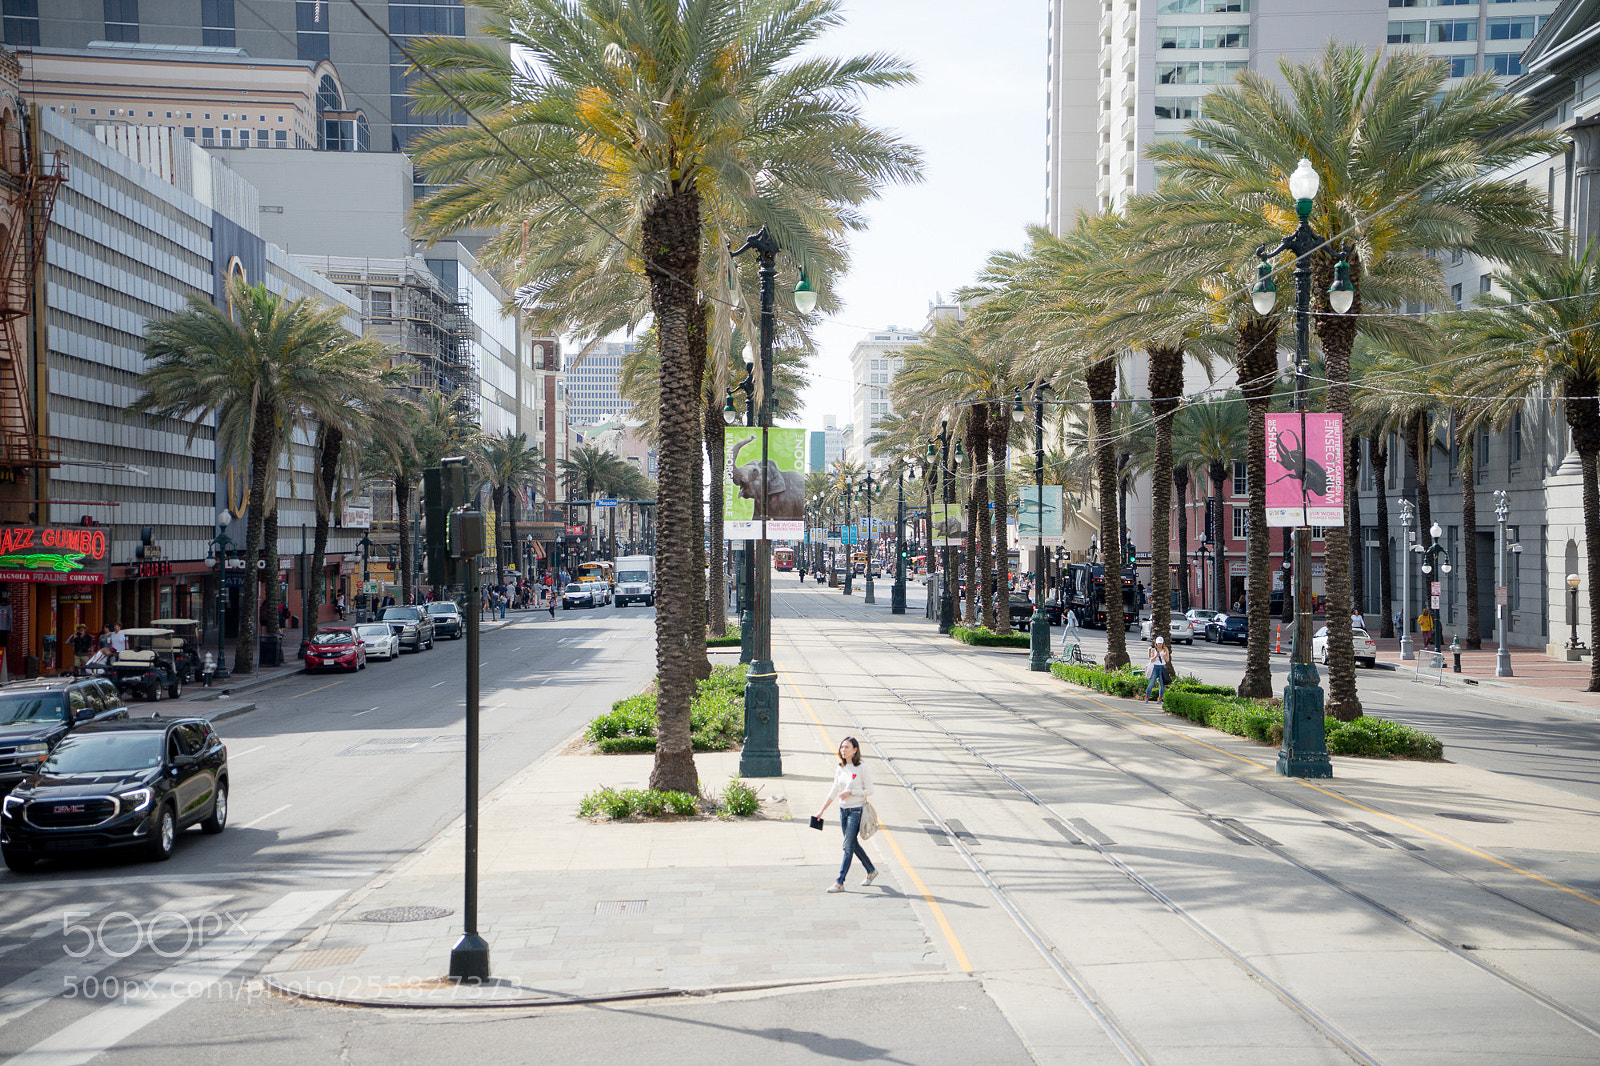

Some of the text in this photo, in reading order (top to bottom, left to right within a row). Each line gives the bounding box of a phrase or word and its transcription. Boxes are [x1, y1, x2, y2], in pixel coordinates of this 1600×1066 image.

[794, 438, 804, 470] ZOO
[1268, 427, 1277, 463] SHARP
[725, 438, 734, 517] UNFORGETTABLE
[1325, 426, 1335, 504] INSECTARIUM
[42, 528, 105, 560] GUMBO
[32, 573, 67, 582] PRALINE
[69, 574, 99, 582] COMPANY
[139, 562, 159, 577] CIGAR
[53, 804, 85, 814] GMC
